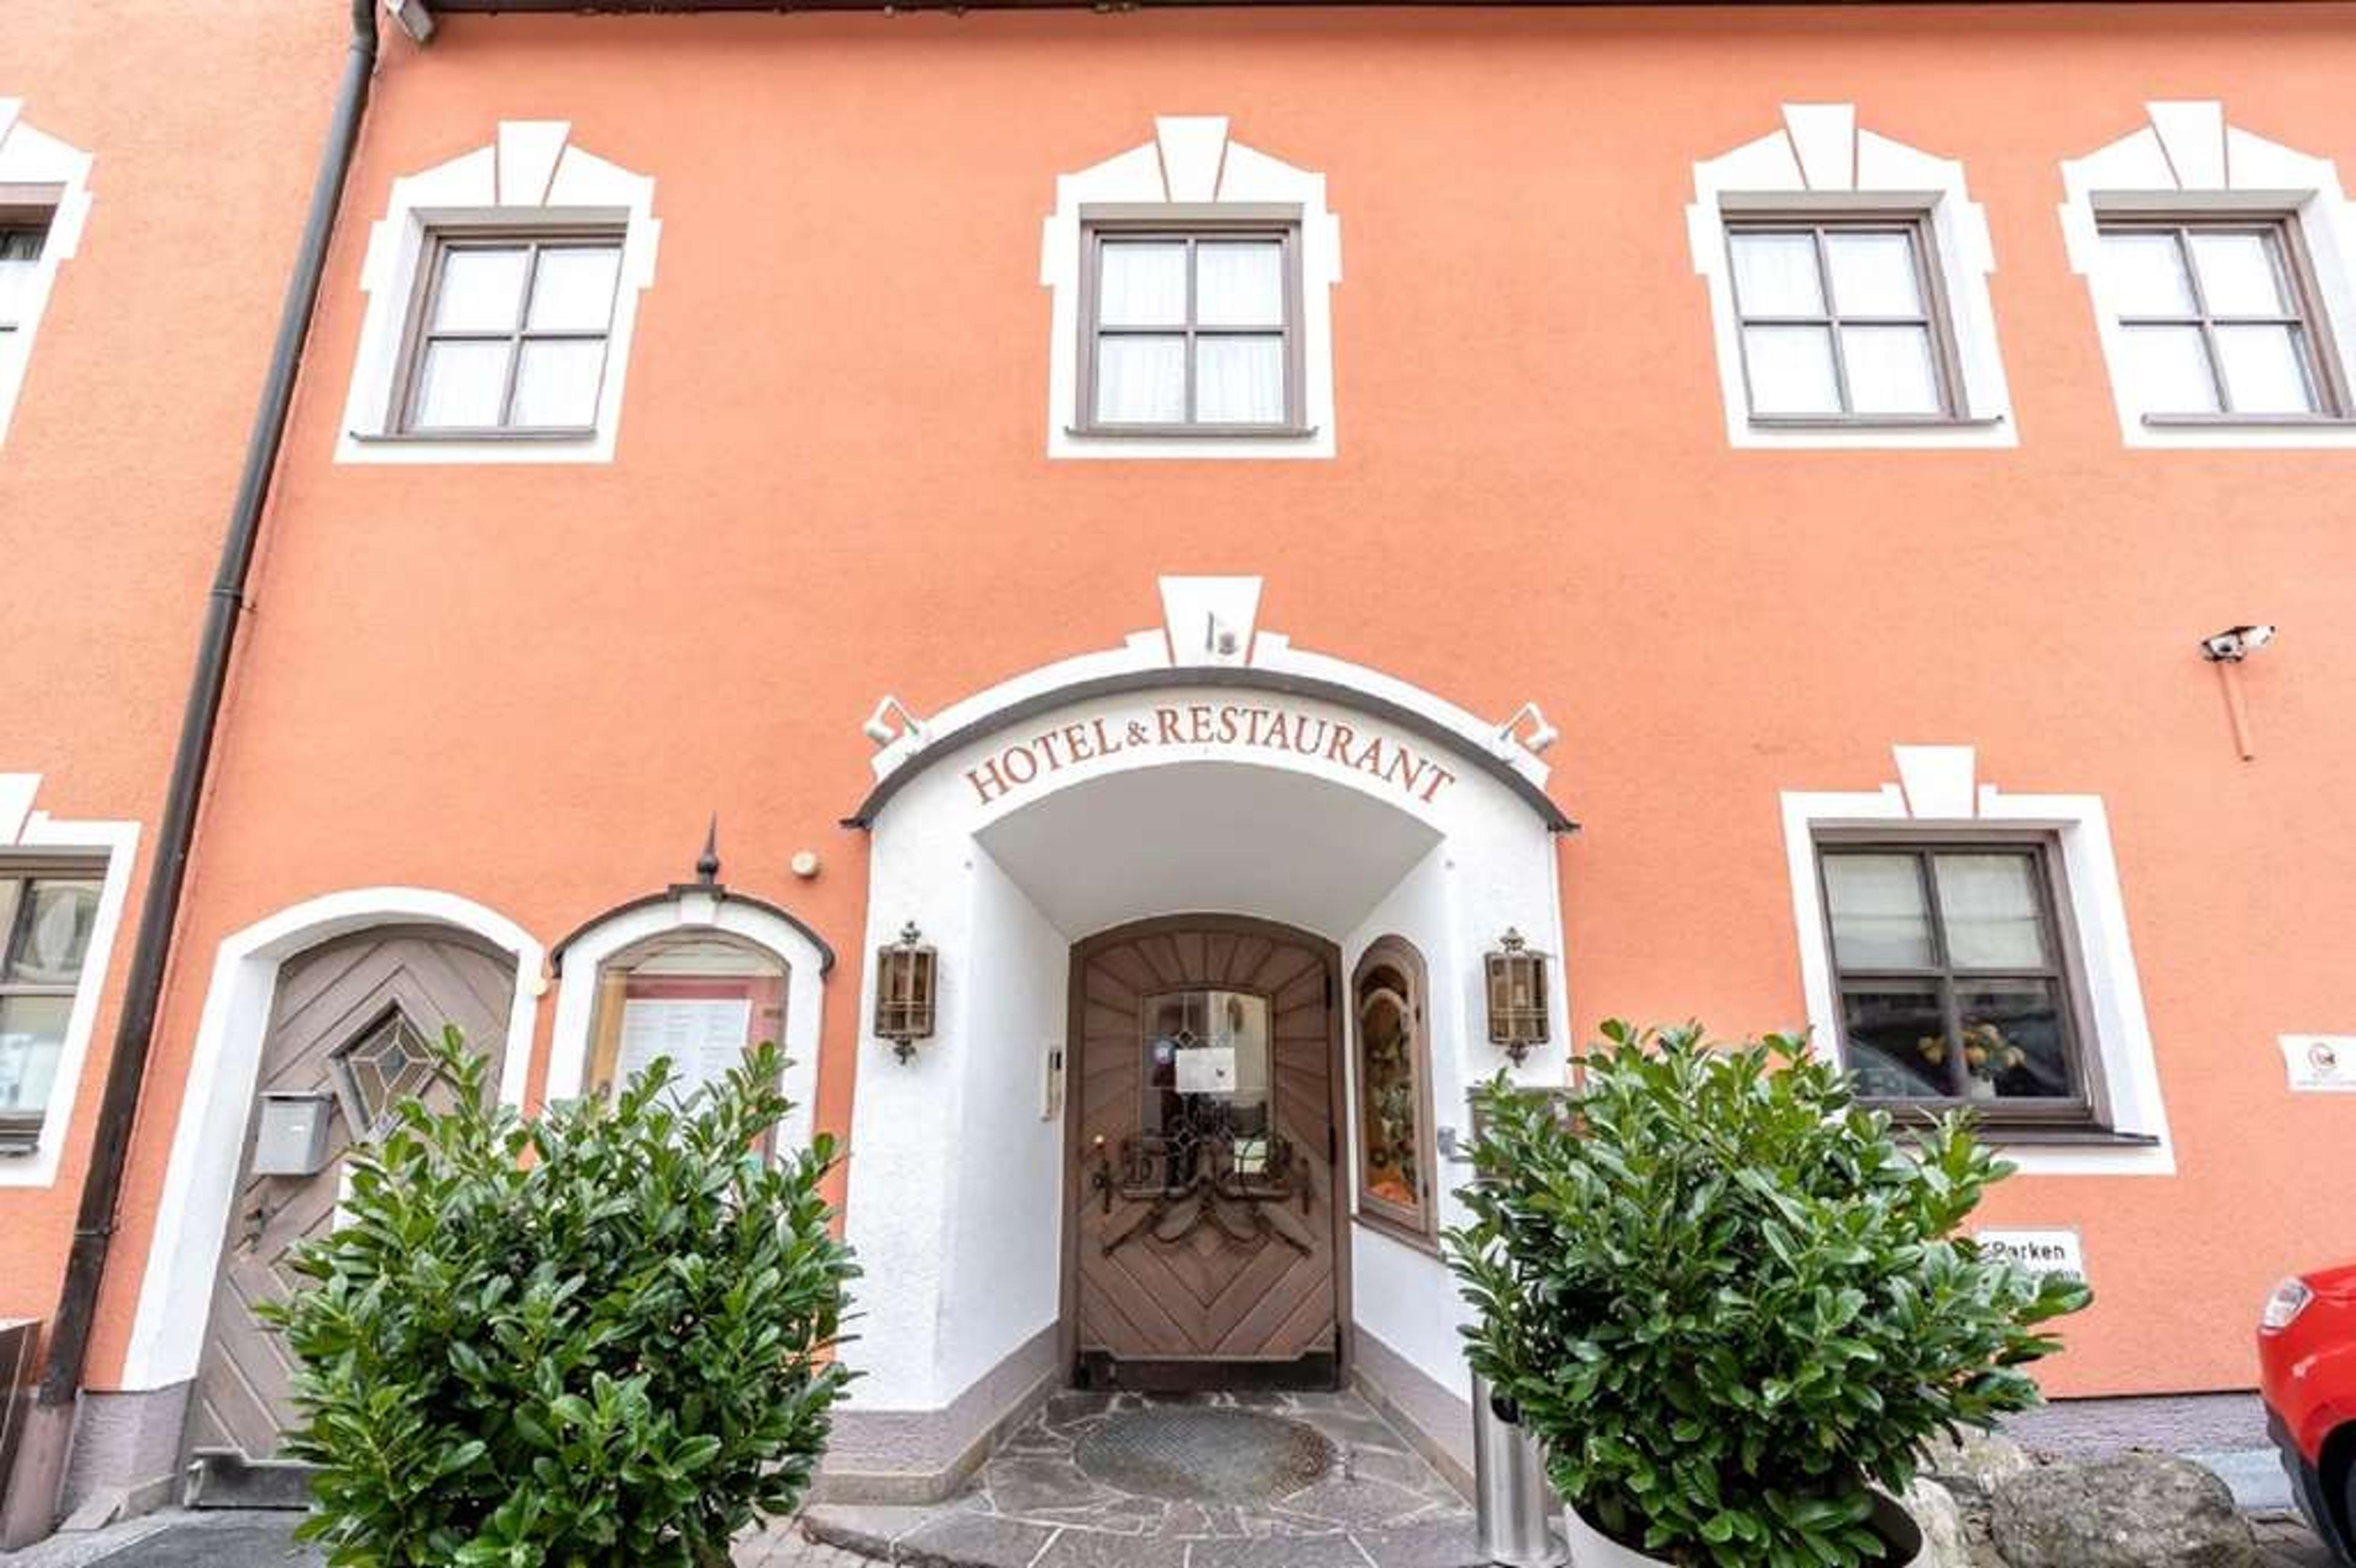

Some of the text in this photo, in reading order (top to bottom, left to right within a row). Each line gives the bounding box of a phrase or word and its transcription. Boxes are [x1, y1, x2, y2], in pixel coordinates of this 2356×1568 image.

[965, 706, 1456, 804] HOTEL & RESTAURANT
